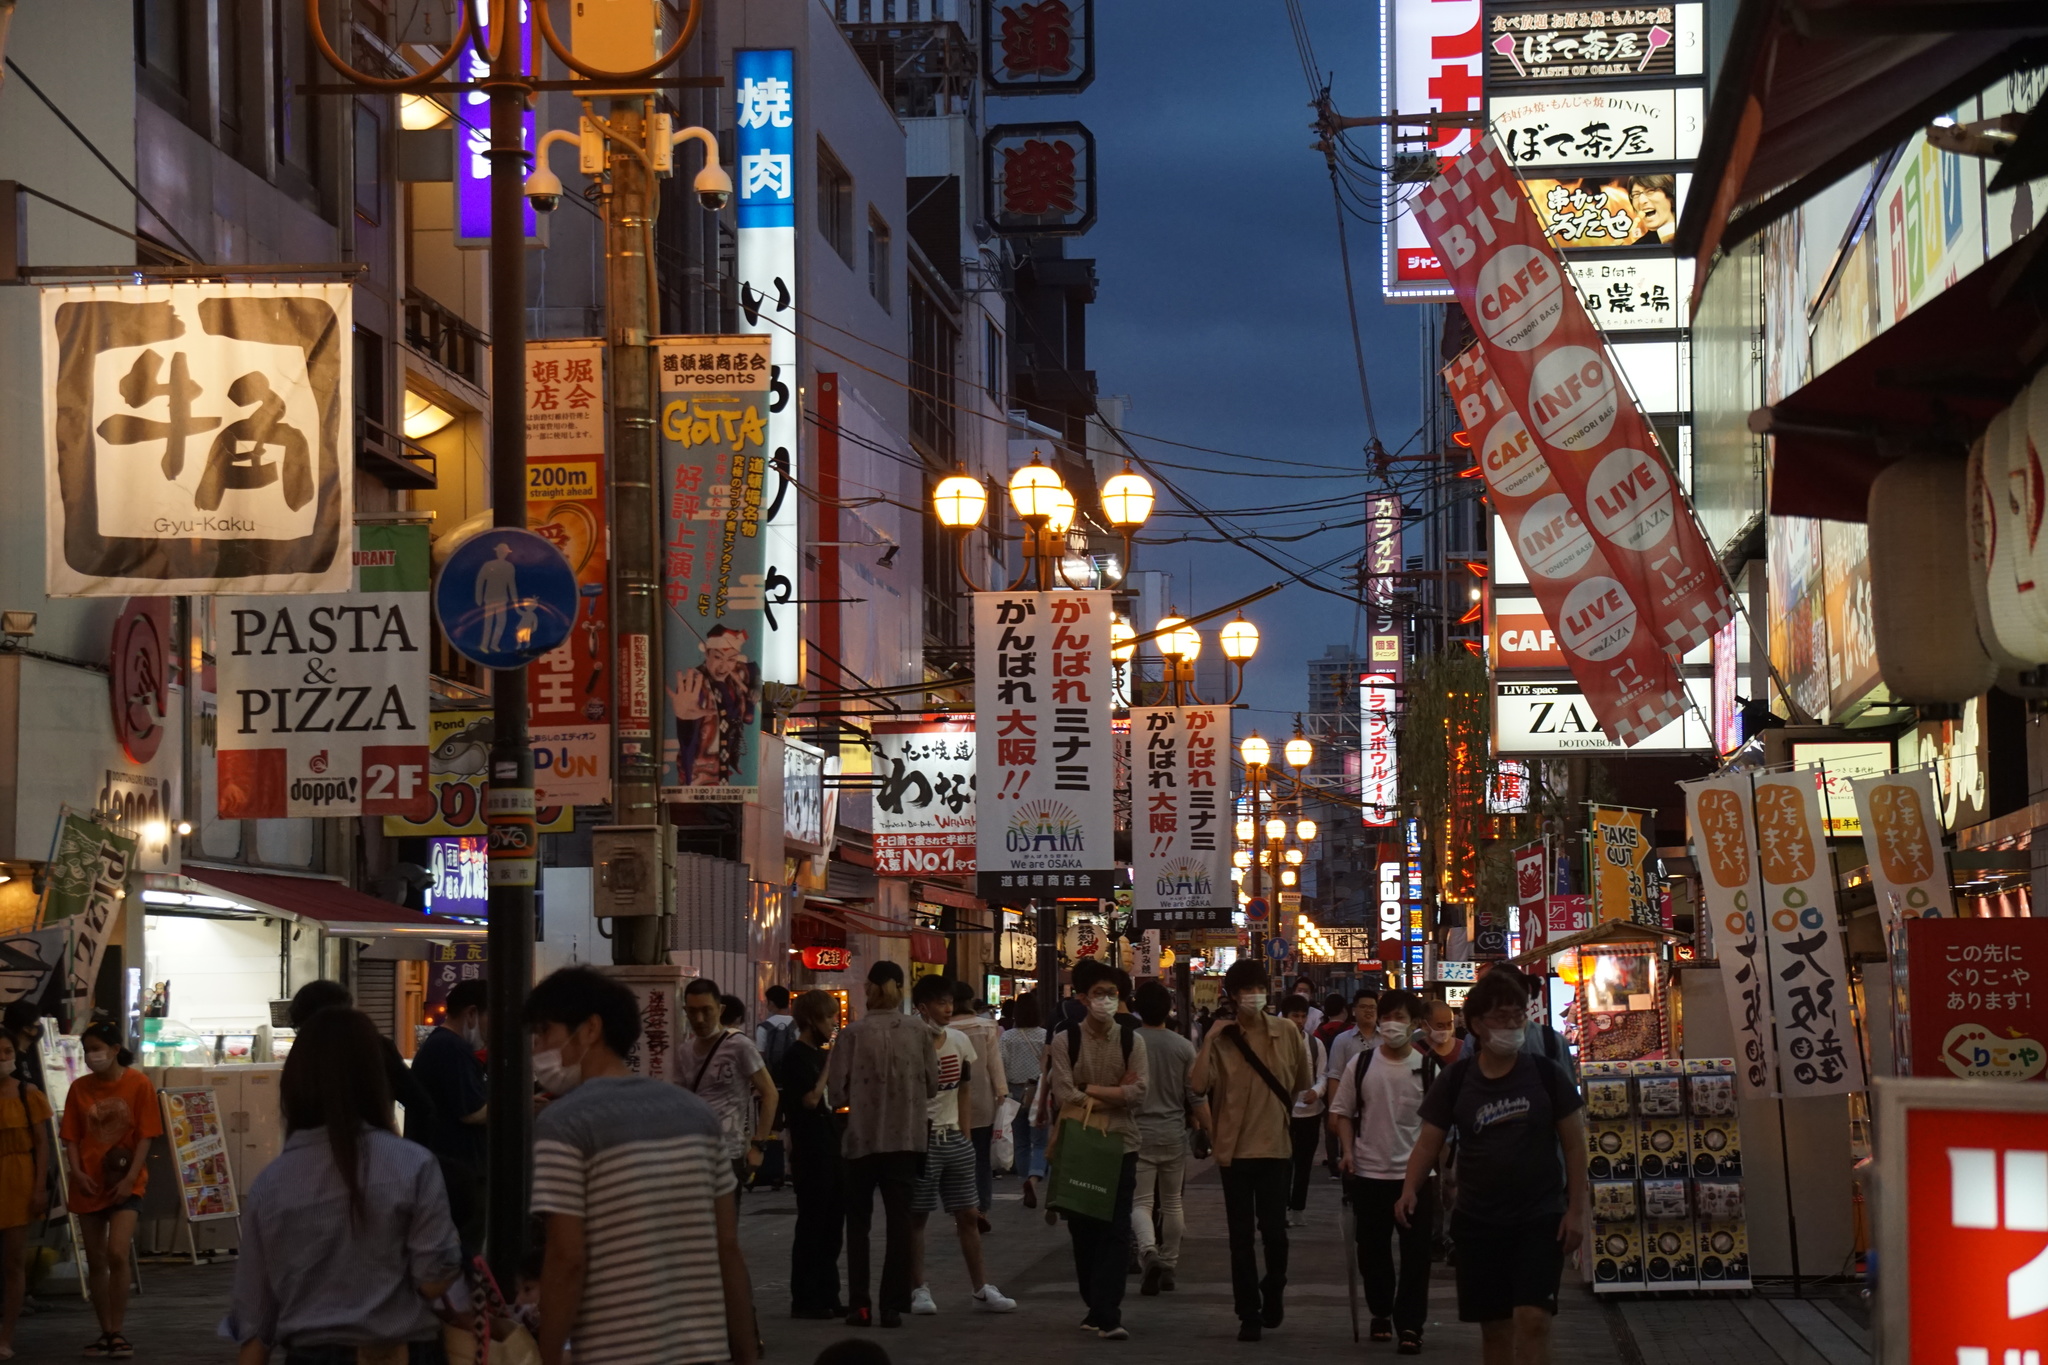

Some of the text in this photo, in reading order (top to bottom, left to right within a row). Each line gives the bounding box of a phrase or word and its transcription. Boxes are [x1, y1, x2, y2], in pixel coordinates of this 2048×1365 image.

[1493, 14, 1548, 31] 食べ放題
[1523, 30, 1642, 63] ぼて茶屋
[1685, 31, 1696, 48] 3
[1531, 63, 1631, 77] TASTE OF OSAKA
[1608, 97, 1661, 120] DINING
[1686, 115, 1696, 132] 3
[738, 75, 791, 202] 焼肉
[1507, 121, 1654, 162] ぼて茶屋
[1547, 185, 1608, 212] 串かつ
[1437, 204, 1497, 271] B1
[1481, 255, 1549, 321] CAFE
[1505, 302, 1561, 347] TONBORI BASE
[663, 353, 767, 372] 道頓堀商店会
[674, 372, 756, 386] presents
[1533, 360, 1604, 426] INFO
[1459, 379, 1504, 430] B1
[96, 348, 315, 513] 牛角
[1562, 405, 1616, 448] TONBORI BASE
[530, 467, 587, 487] 200m
[1505, 470, 1535, 493] TONBORI
[1594, 461, 1657, 520] LIVE
[530, 486, 593, 499] straight ahead
[741, 456, 765, 538] 道頓堀名物
[153, 516, 256, 537] Gyu-Kaku
[665, 463, 703, 608] 好評上演中
[1523, 506, 1584, 557] INFO
[1545, 542, 1593, 576] TONBORI BASE
[1565, 587, 1624, 637] LIVE
[230, 604, 418, 656] PASTA
[1500, 630, 1561, 652] CAF
[303, 657, 339, 685] &
[996, 600, 1037, 800] がんばれ大阪!!
[1051, 598, 1092, 792] がんばれミナミ
[1503, 686, 1558, 697] LIVE space
[237, 683, 417, 735] PIZZA
[1528, 702, 1604, 734] ZA
[434, 719, 465, 731] Pond
[291, 777, 358, 806] doppa!
[365, 763, 422, 800] 2F
[1186, 710, 1216, 851] がんばれミナミ
[1006, 812, 1085, 852] OSAKA
[1600, 824, 1639, 848] TAKE
[902, 848, 955, 872] No.1
[1010, 859, 1083, 869] We are OSAKA
[1605, 847, 1634, 868] OUT
[1001, 874, 1091, 887] 道頓堀商店会
[1153, 911, 1217, 921] 道頓堀商店会
[1160, 900, 1171, 908] We
[1185, 899, 1211, 908] OSAKA
[1945, 943, 2023, 963] この先に
[1946, 990, 2031, 1011] あります!
